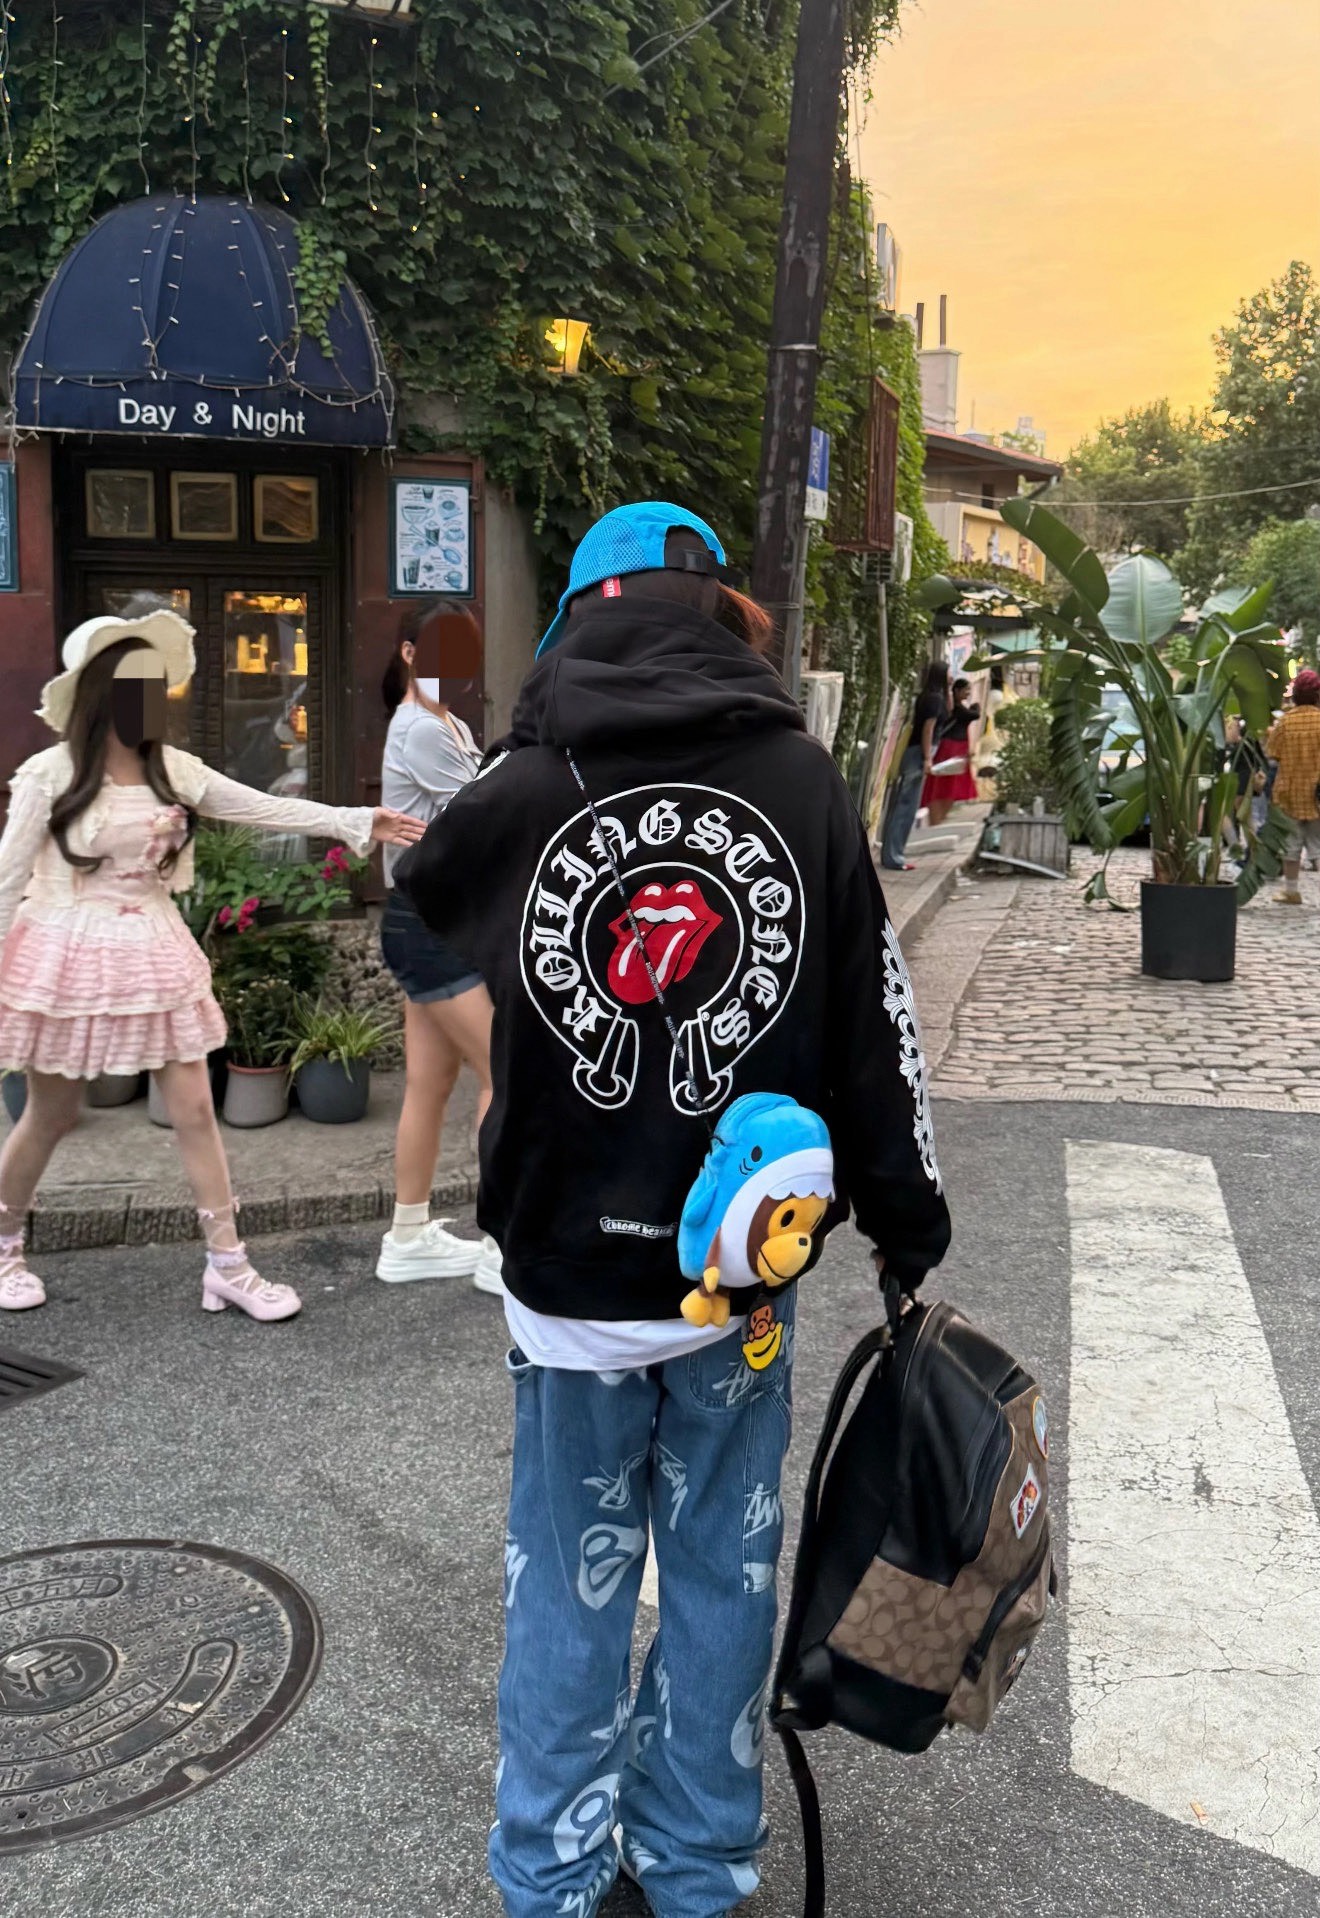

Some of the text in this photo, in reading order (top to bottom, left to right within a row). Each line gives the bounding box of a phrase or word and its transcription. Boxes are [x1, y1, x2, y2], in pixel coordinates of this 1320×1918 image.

[119, 398, 306, 438] Day & Night
